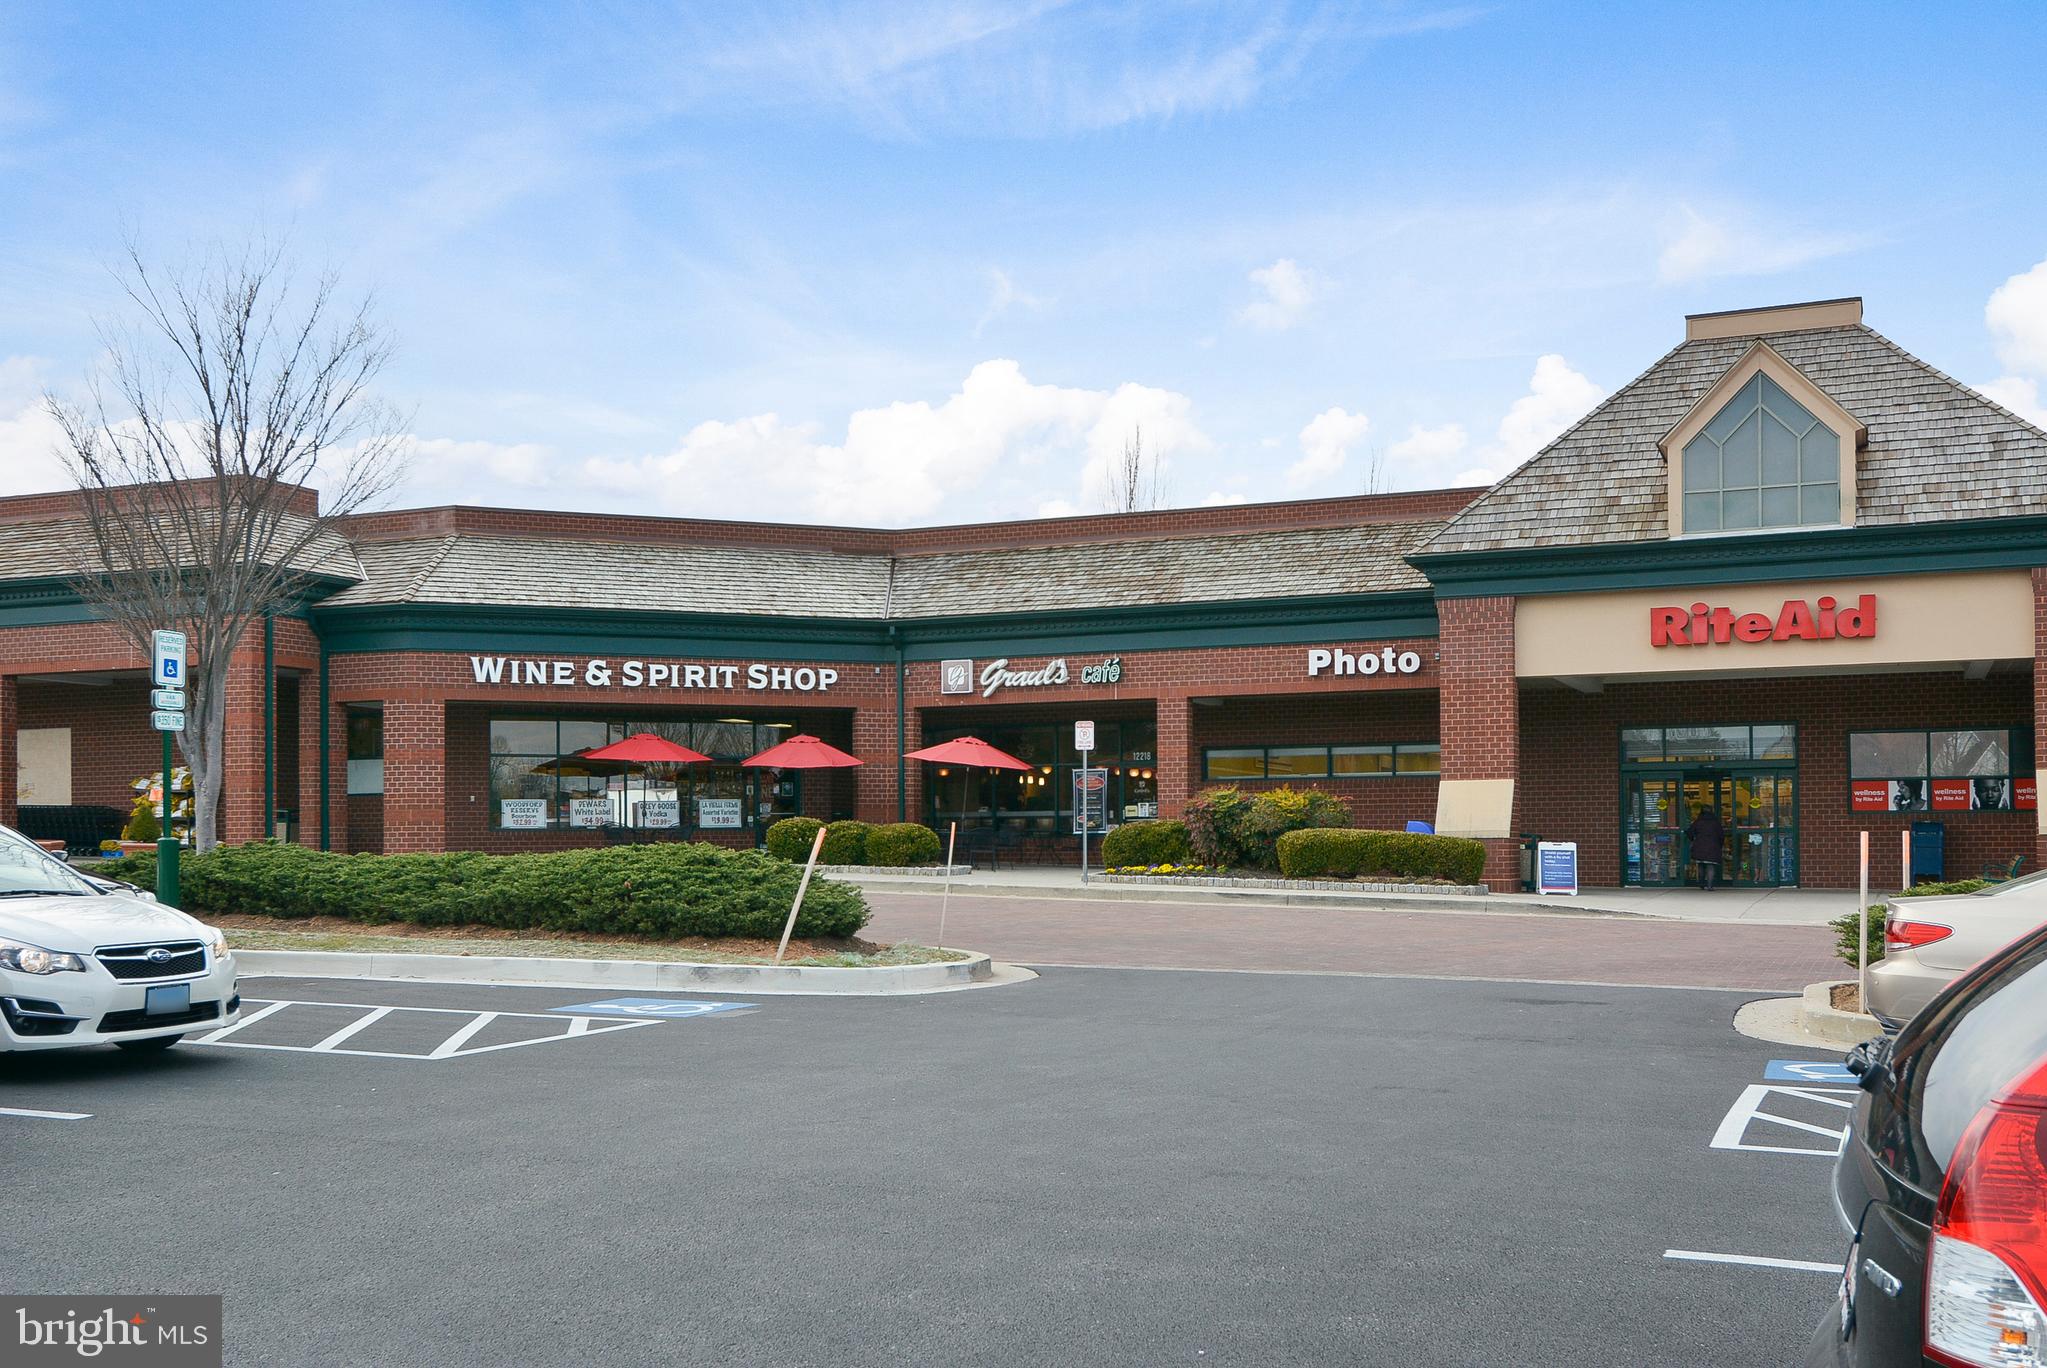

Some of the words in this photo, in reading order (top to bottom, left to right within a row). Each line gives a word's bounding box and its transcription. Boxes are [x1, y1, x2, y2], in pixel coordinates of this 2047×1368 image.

[1308, 647, 1421, 676] Photo
[470, 656, 576, 686] WINE
[584, 660, 612, 686] &
[622, 661, 739, 689] SPIRIT
[747, 664, 839, 691] SHOP
[980, 658, 1070, 698] Graul's
[1081, 658, 1121, 684] café
[1133, 752, 1151, 761] 12218
[575, 808, 594, 816] White
[595, 808, 611, 816] Label
[657, 802, 677, 810] GOOSE
